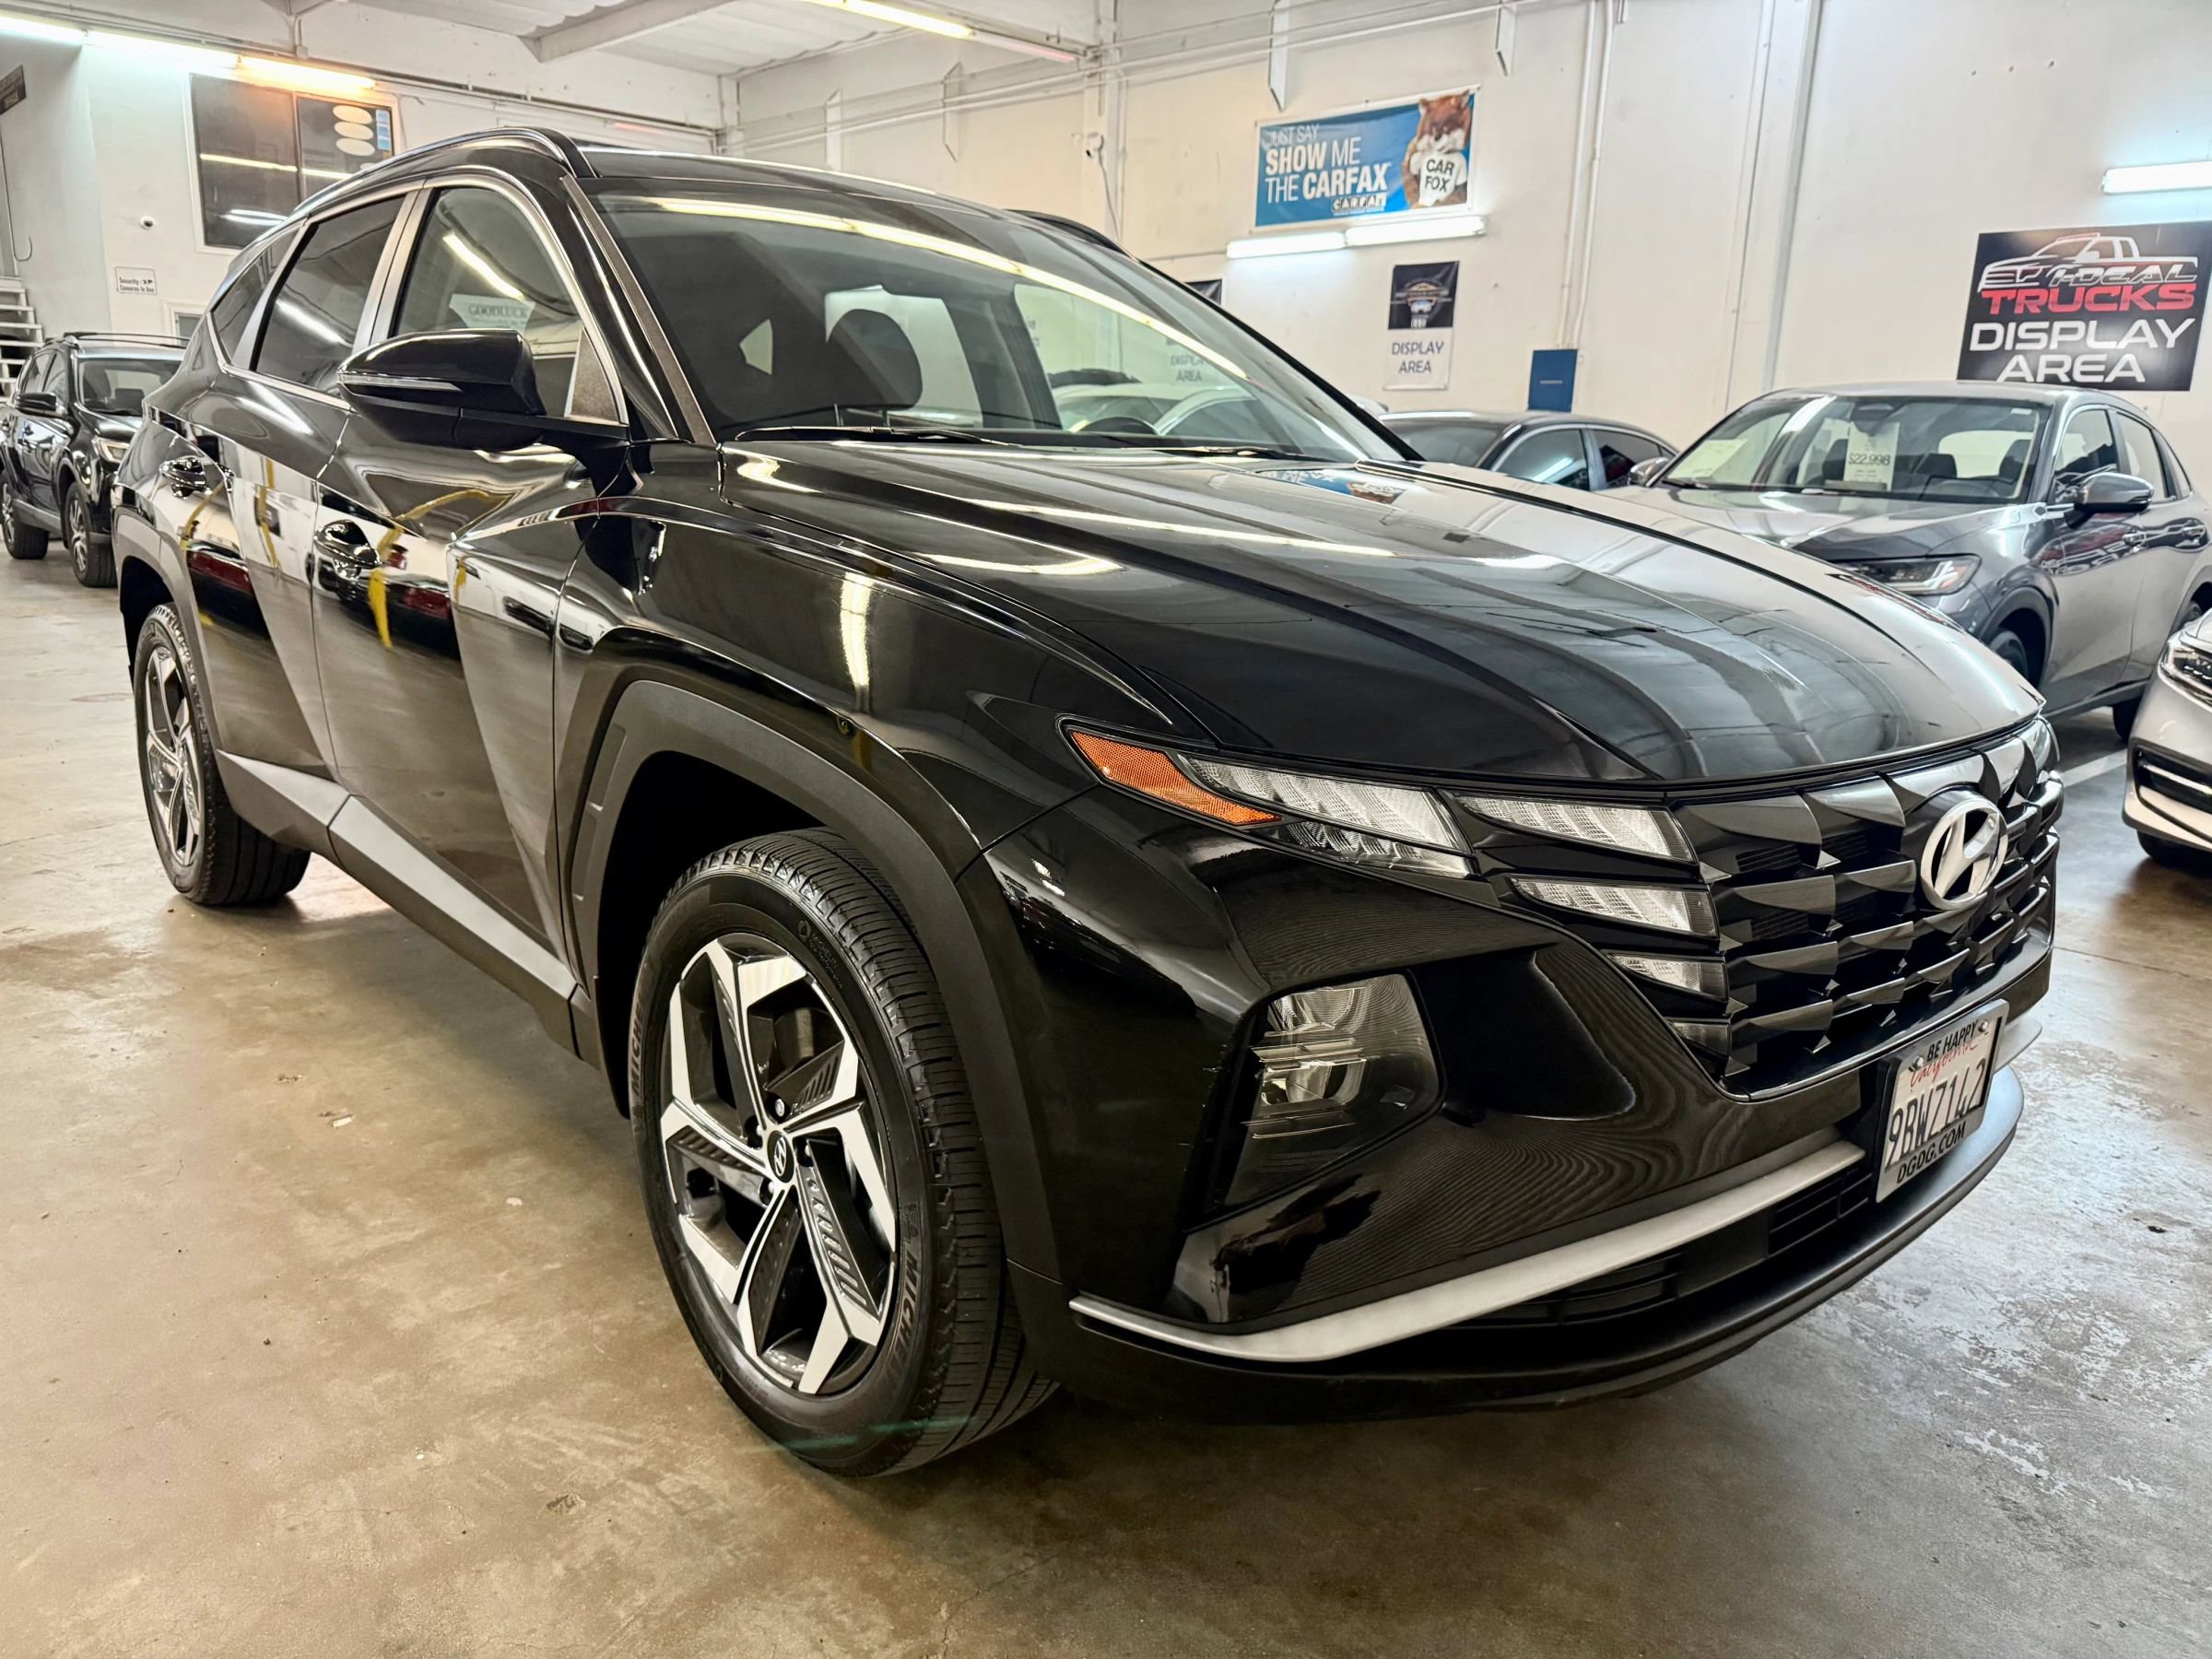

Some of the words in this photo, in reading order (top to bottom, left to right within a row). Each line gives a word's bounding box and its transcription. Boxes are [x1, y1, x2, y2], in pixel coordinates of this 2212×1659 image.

[1297, 124, 1319, 143] SAY
[1265, 142, 1327, 175] SHOW
[1332, 136, 1361, 167] ME
[1427, 159, 1454, 176] CAR
[1265, 174, 1300, 203] THE
[1302, 162, 1392, 200] CARFAX
[1425, 175, 1450, 193] FOX
[1981, 283, 2196, 315] TRUCKS
[1391, 341, 1444, 356] DISPLAY
[1970, 318, 2195, 352] DISPLAY
[1171, 355, 1204, 366] DISPL
[1398, 360, 1431, 373] AREA
[1996, 353, 2147, 383] AREA
[1926, 1040, 1942, 1062] BE
[1942, 1019, 1979, 1054] HAPPY
[1897, 1121, 1966, 1183] DGDG.COM
